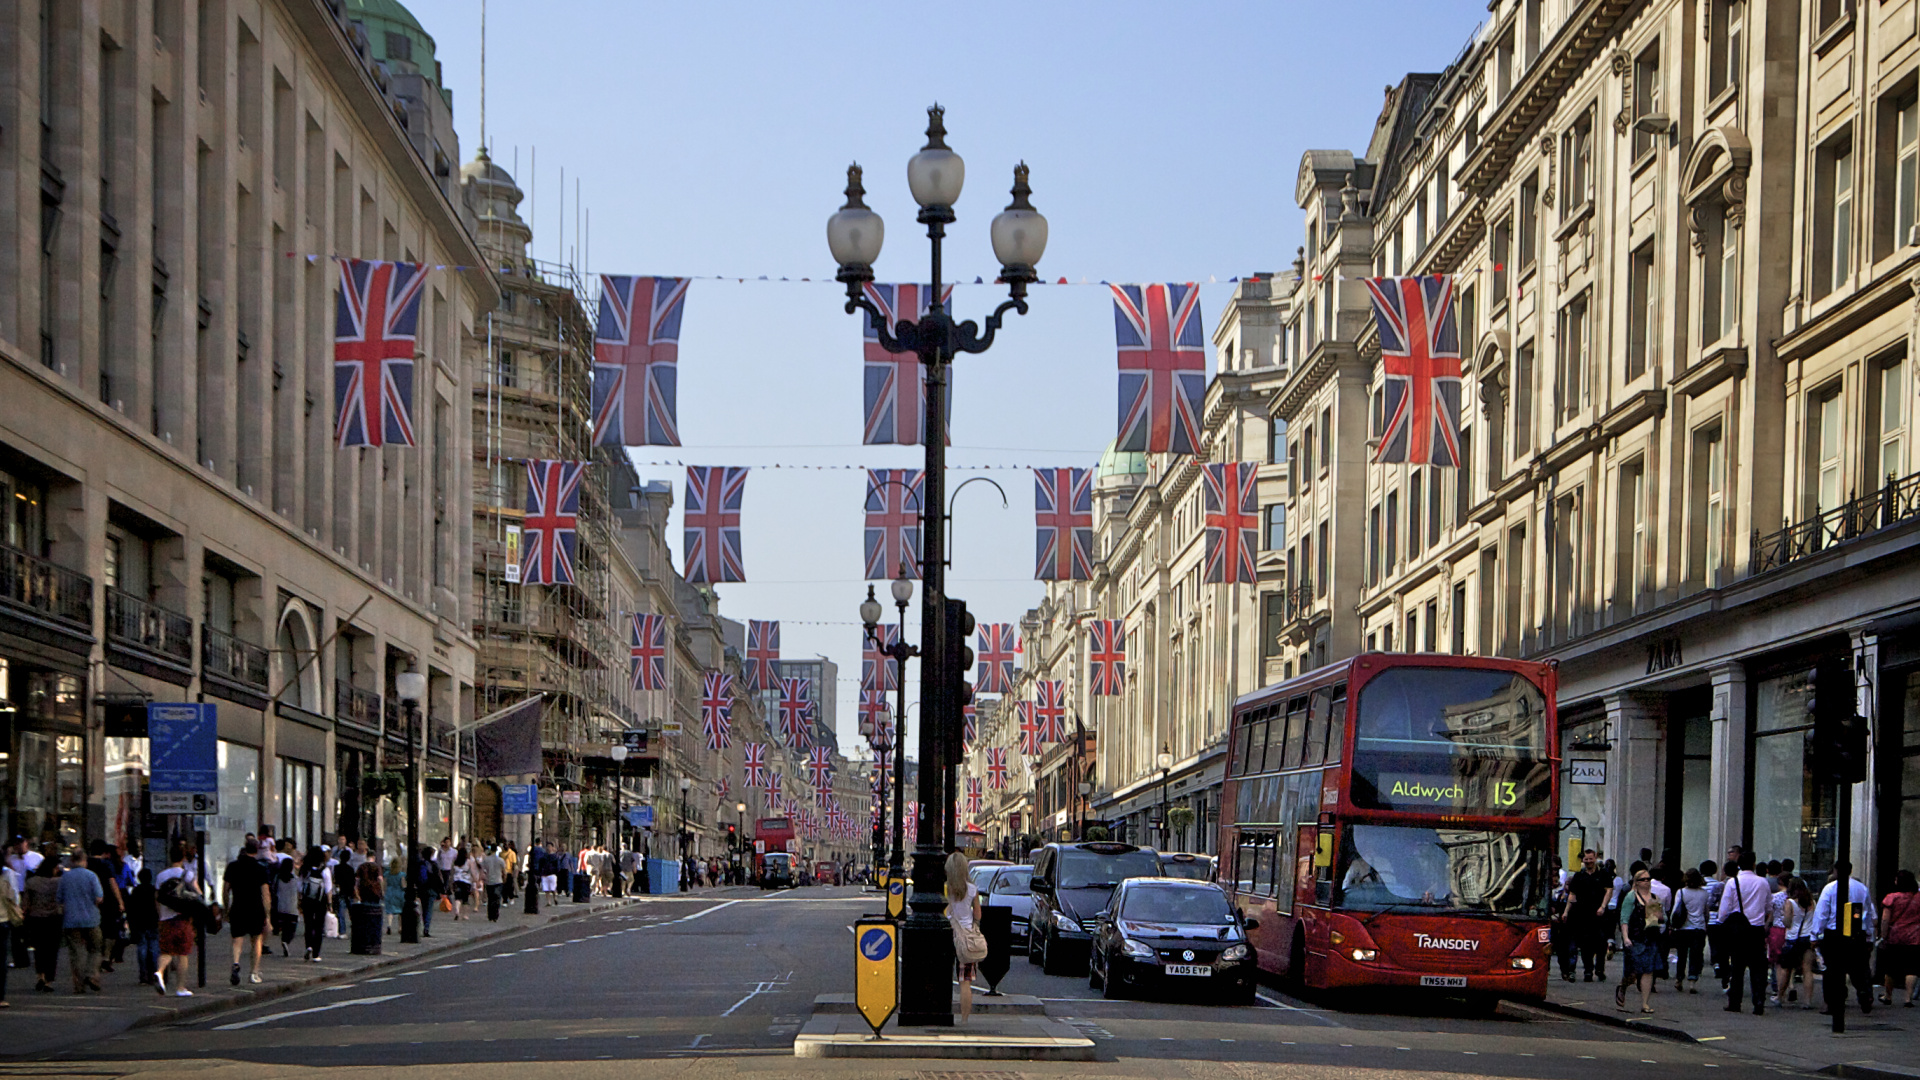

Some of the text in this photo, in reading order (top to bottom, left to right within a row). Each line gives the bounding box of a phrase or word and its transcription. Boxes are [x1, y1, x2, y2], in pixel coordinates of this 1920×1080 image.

[1572, 767, 1604, 777] ZARA
[1391, 781, 1516, 805] Aldwych 13
[1169, 965, 1208, 975] YA05 EYP
